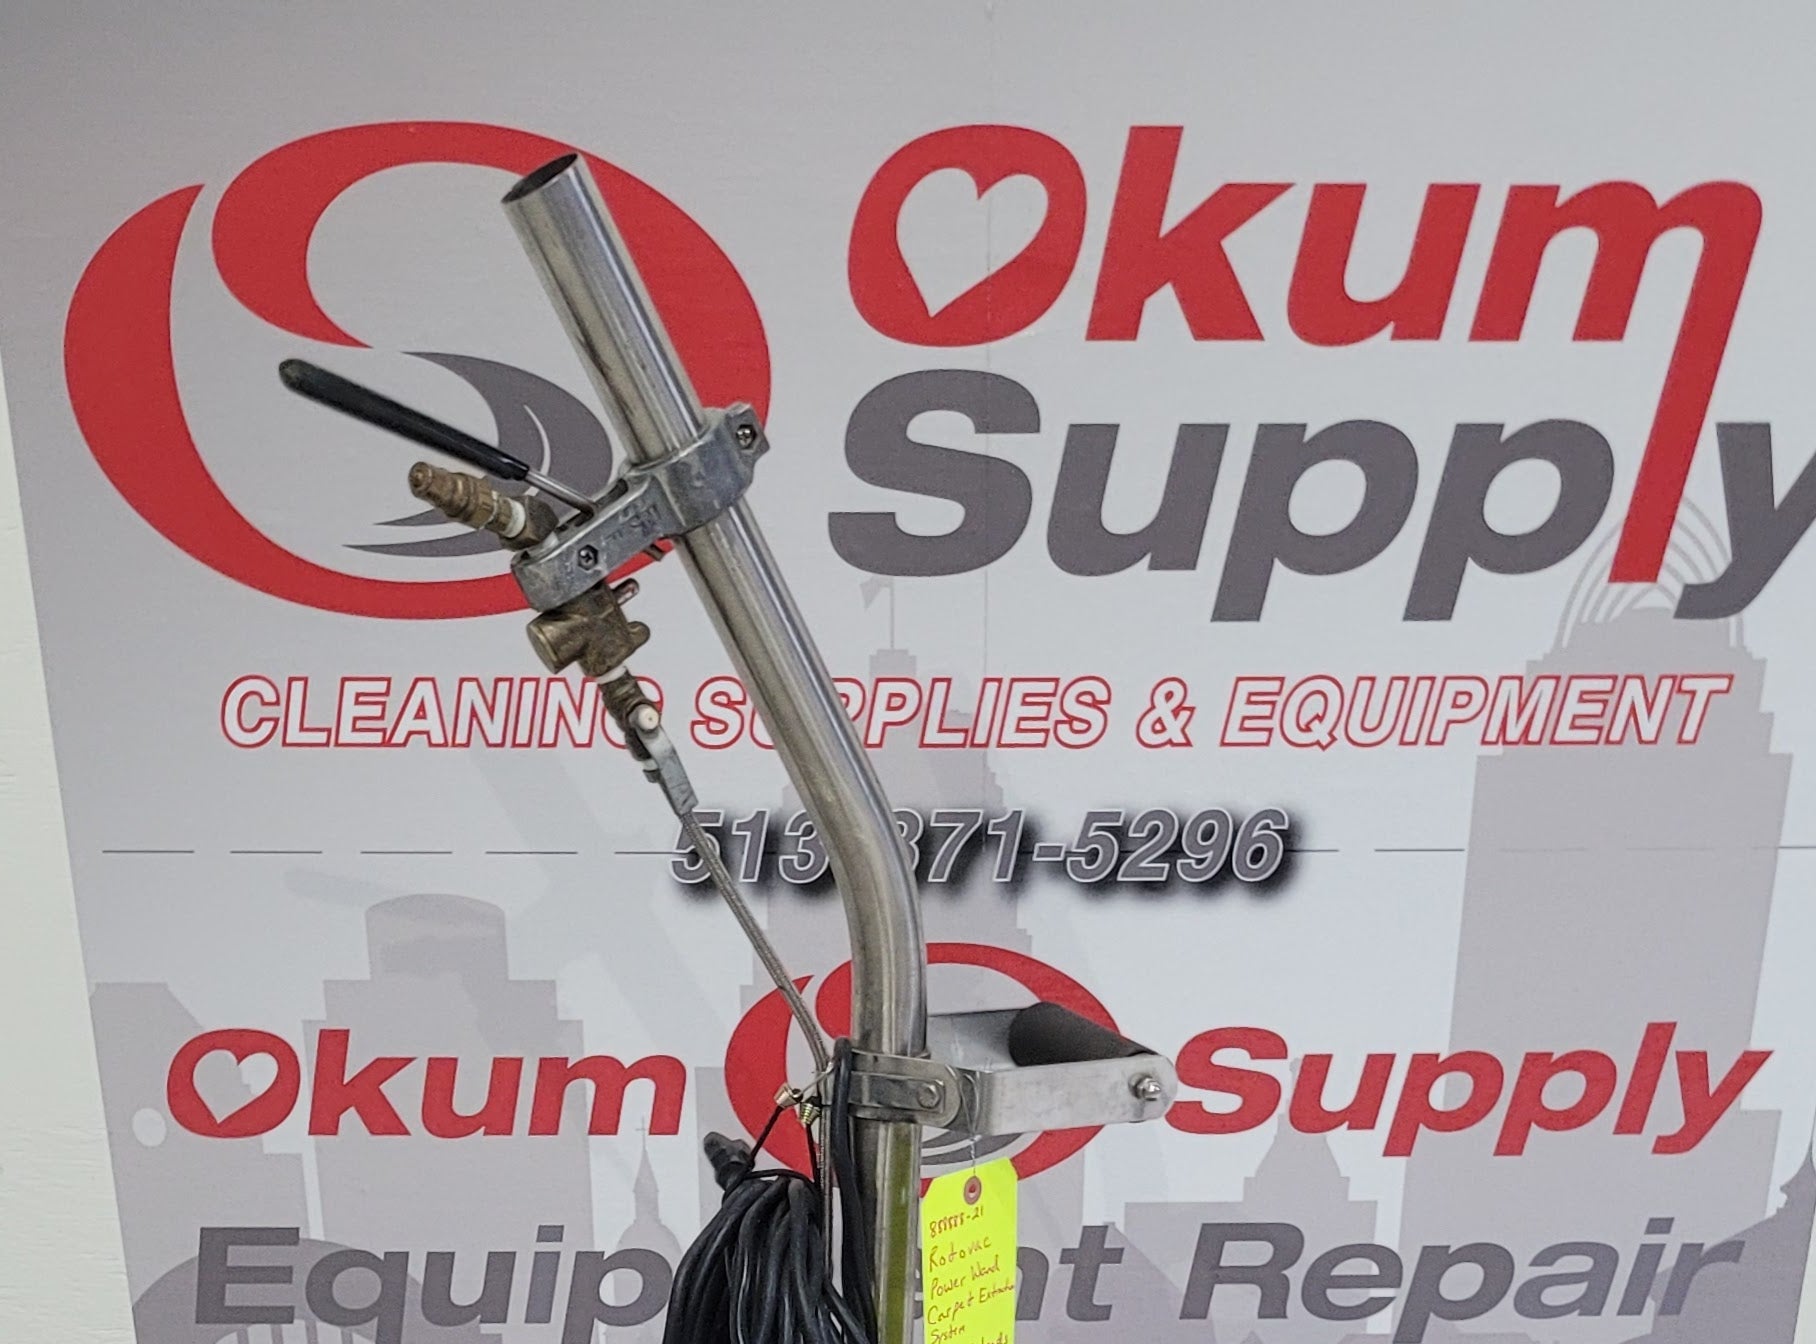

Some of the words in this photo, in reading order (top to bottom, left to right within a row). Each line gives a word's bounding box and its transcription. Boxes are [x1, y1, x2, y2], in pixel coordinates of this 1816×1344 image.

[846, 124, 1764, 347] Okum
[827, 368, 1816, 623] Supply
[690, 676, 1112, 749] SPLIES
[1136, 676, 1195, 748] &
[1219, 673, 1734, 751] EQUIPMENT
[166, 1028, 688, 1139] Okum
[1166, 1021, 1774, 1157] Supply
[930, 1277, 966, 1300] Power
[1178, 1217, 1745, 1344] Repair
